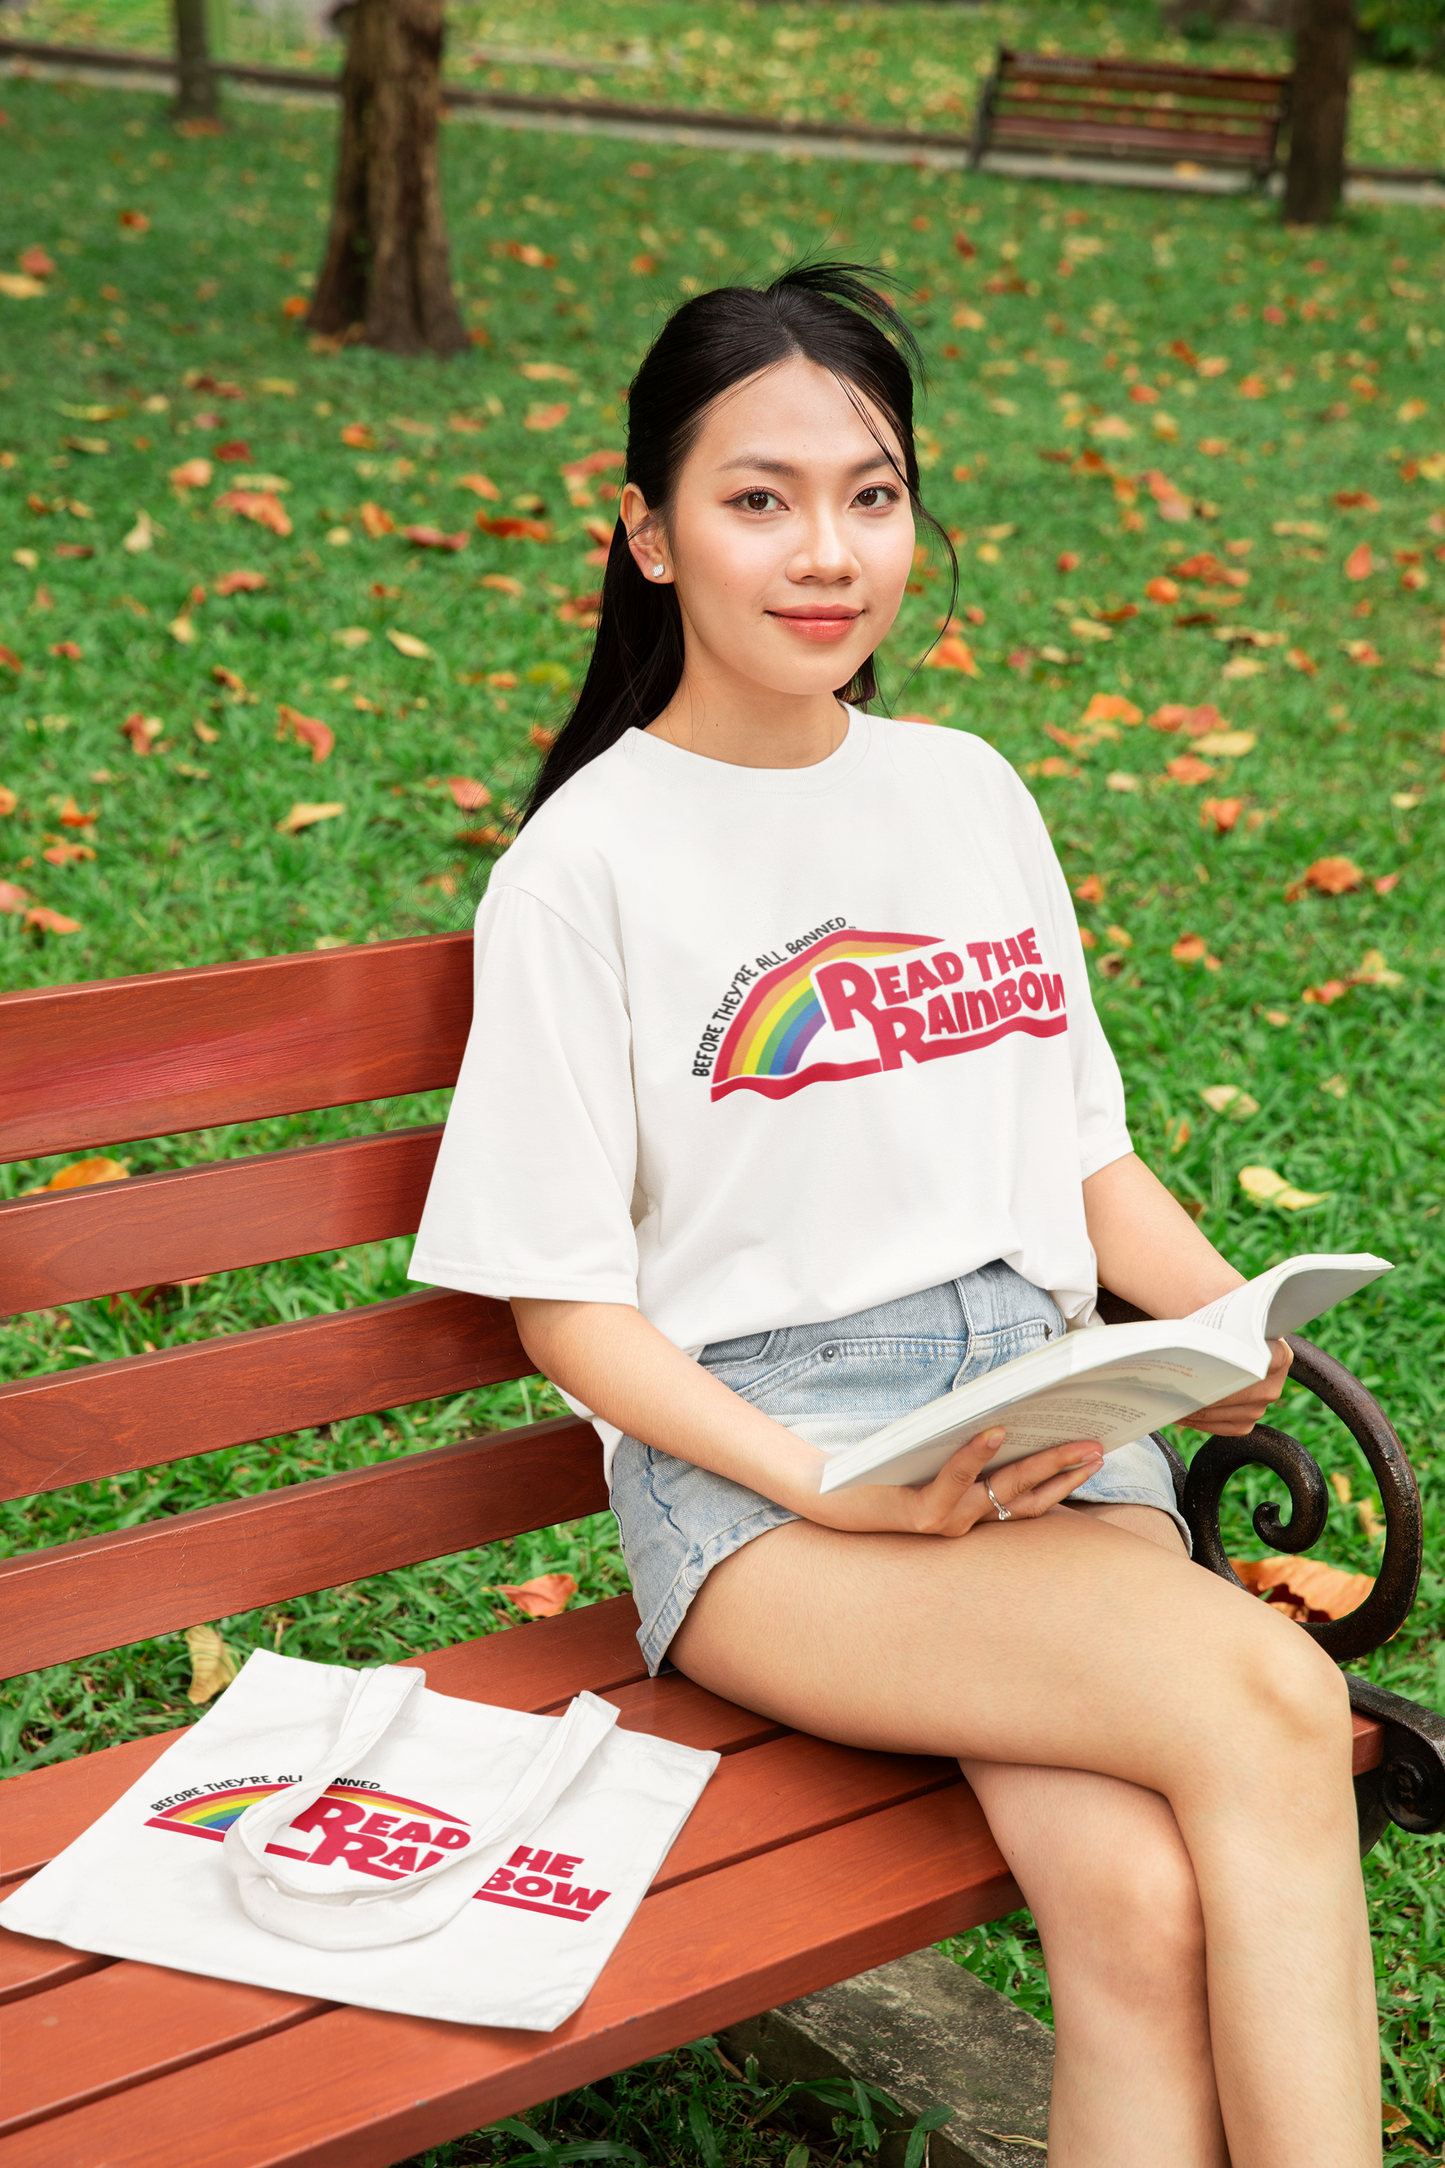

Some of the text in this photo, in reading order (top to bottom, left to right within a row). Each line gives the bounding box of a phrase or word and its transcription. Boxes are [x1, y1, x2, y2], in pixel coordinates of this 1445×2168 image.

[692, 1024, 724, 1077] BEFORE
[712, 964, 758, 1021] THEY'RE
[755, 951, 788, 971] ALL
[815, 927, 1043, 1032] READ THE
[150, 1787, 204, 1811] BEFORE
[204, 1775, 272, 1791] THEY'RE
[289, 1796, 585, 1878] READ HE
